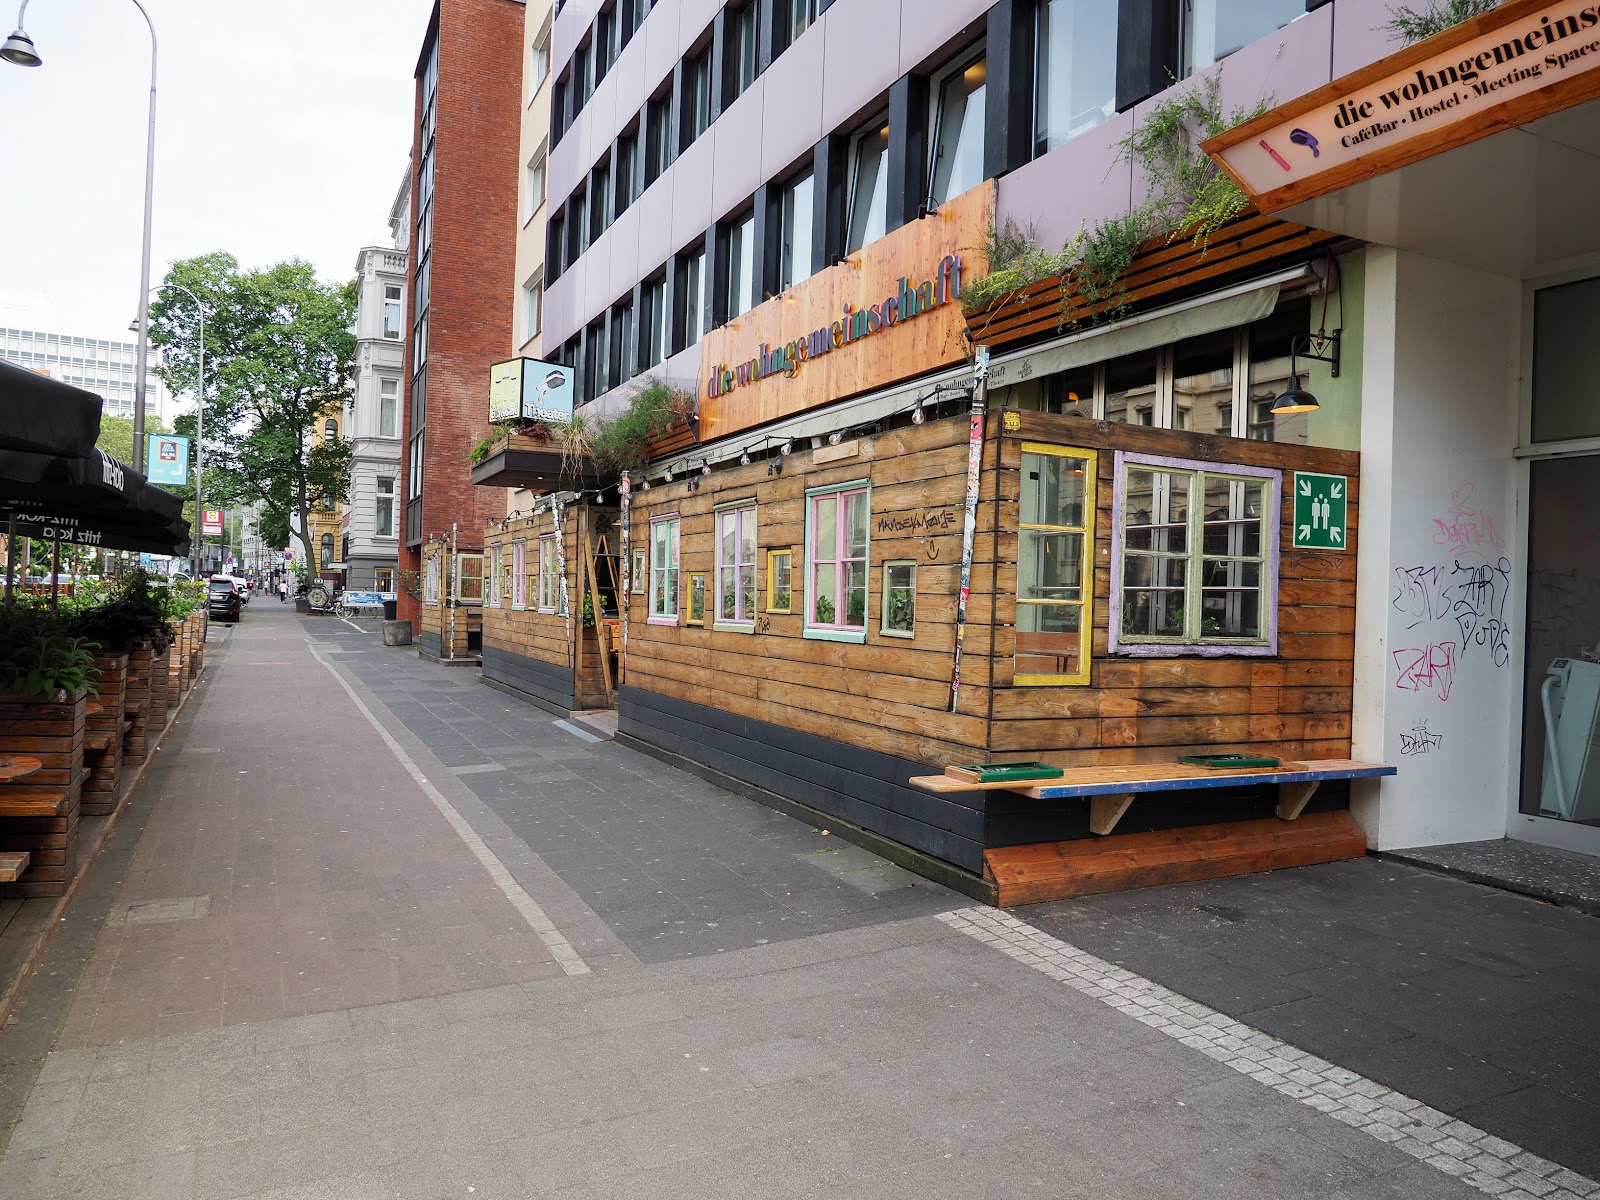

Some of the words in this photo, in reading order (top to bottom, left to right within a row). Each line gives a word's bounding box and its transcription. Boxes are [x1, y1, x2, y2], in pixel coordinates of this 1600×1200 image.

[1333, 100, 1374, 128] die
[1378, 5, 1600, 110] wohngemeins
[1341, 120, 1398, 148] CaféBar
[1408, 92, 1460, 122] Hostel
[1471, 64, 1542, 99] Meeting
[707, 363, 735, 399] die
[735, 254, 965, 388] wohngemeinschaft
[525, 402, 570, 421] Theater
